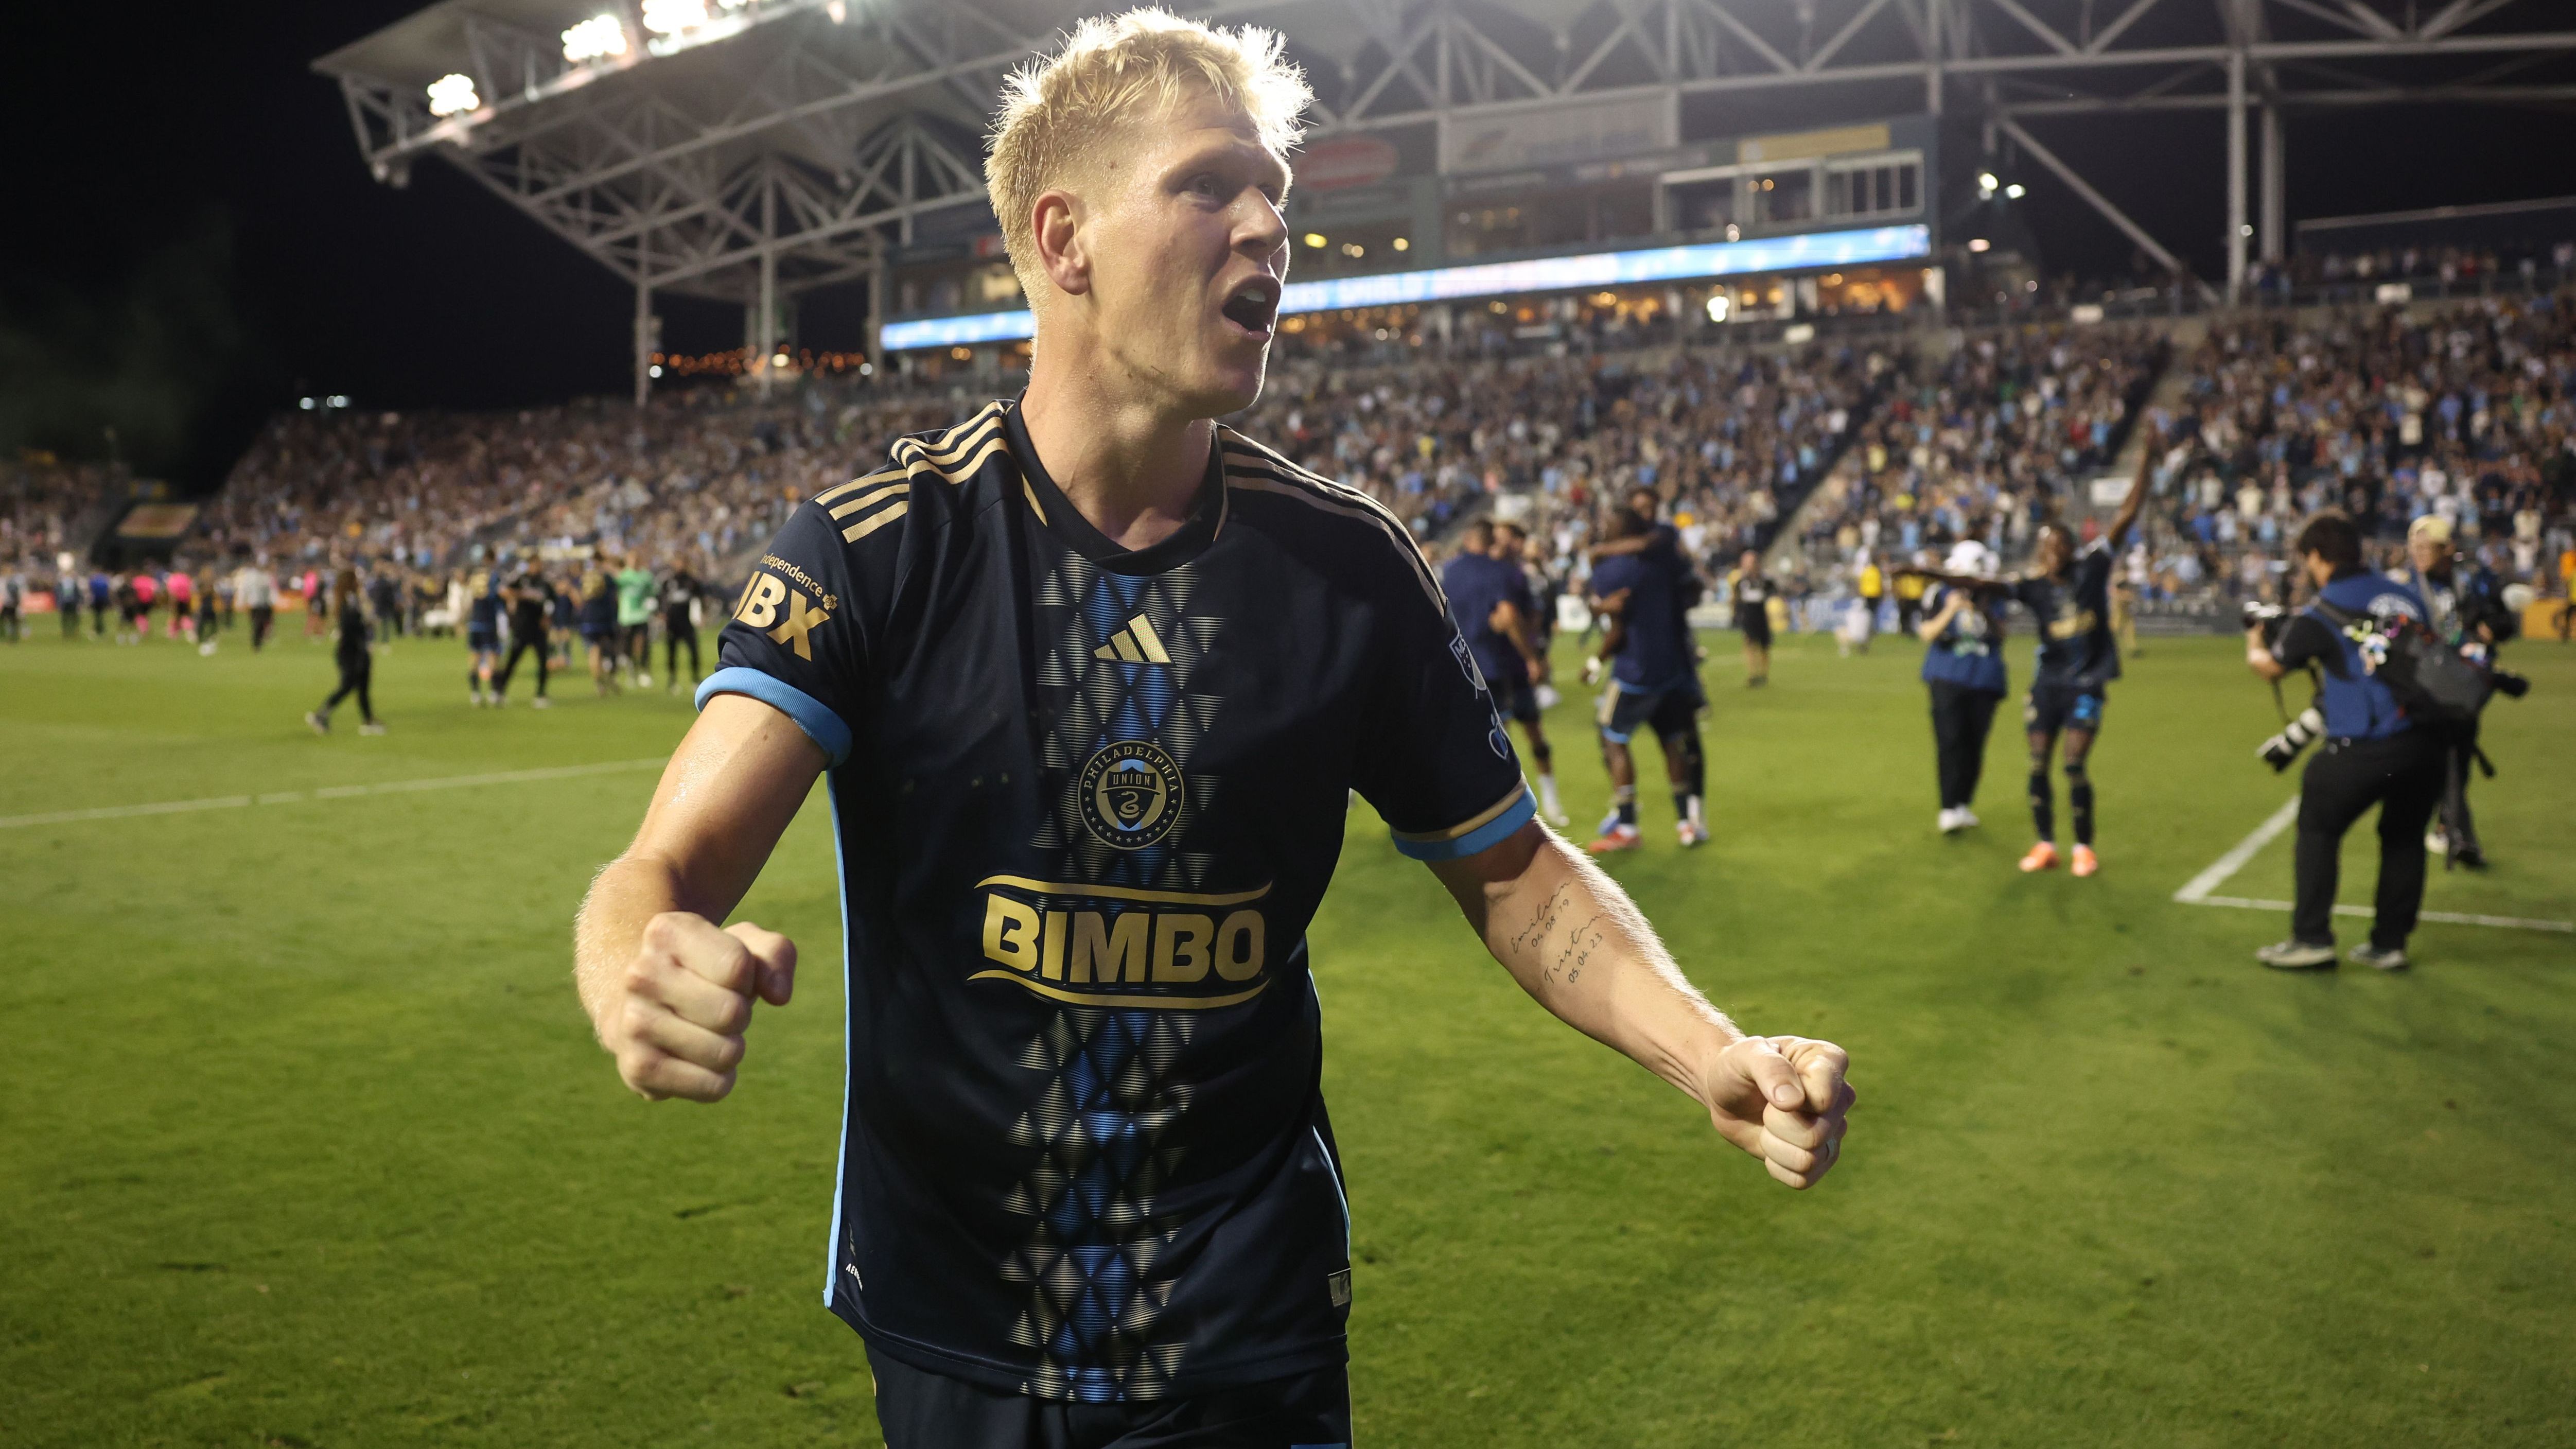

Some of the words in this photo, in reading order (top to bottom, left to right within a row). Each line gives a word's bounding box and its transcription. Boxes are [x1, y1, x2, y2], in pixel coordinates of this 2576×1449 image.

[732, 571, 830, 662] IBX
[1083, 746, 1179, 793] PHILADELPHIA
[1113, 773, 1150, 786] UNION
[983, 893, 1265, 983] BIMBO
[1545, 913, 1605, 984] Tristan
